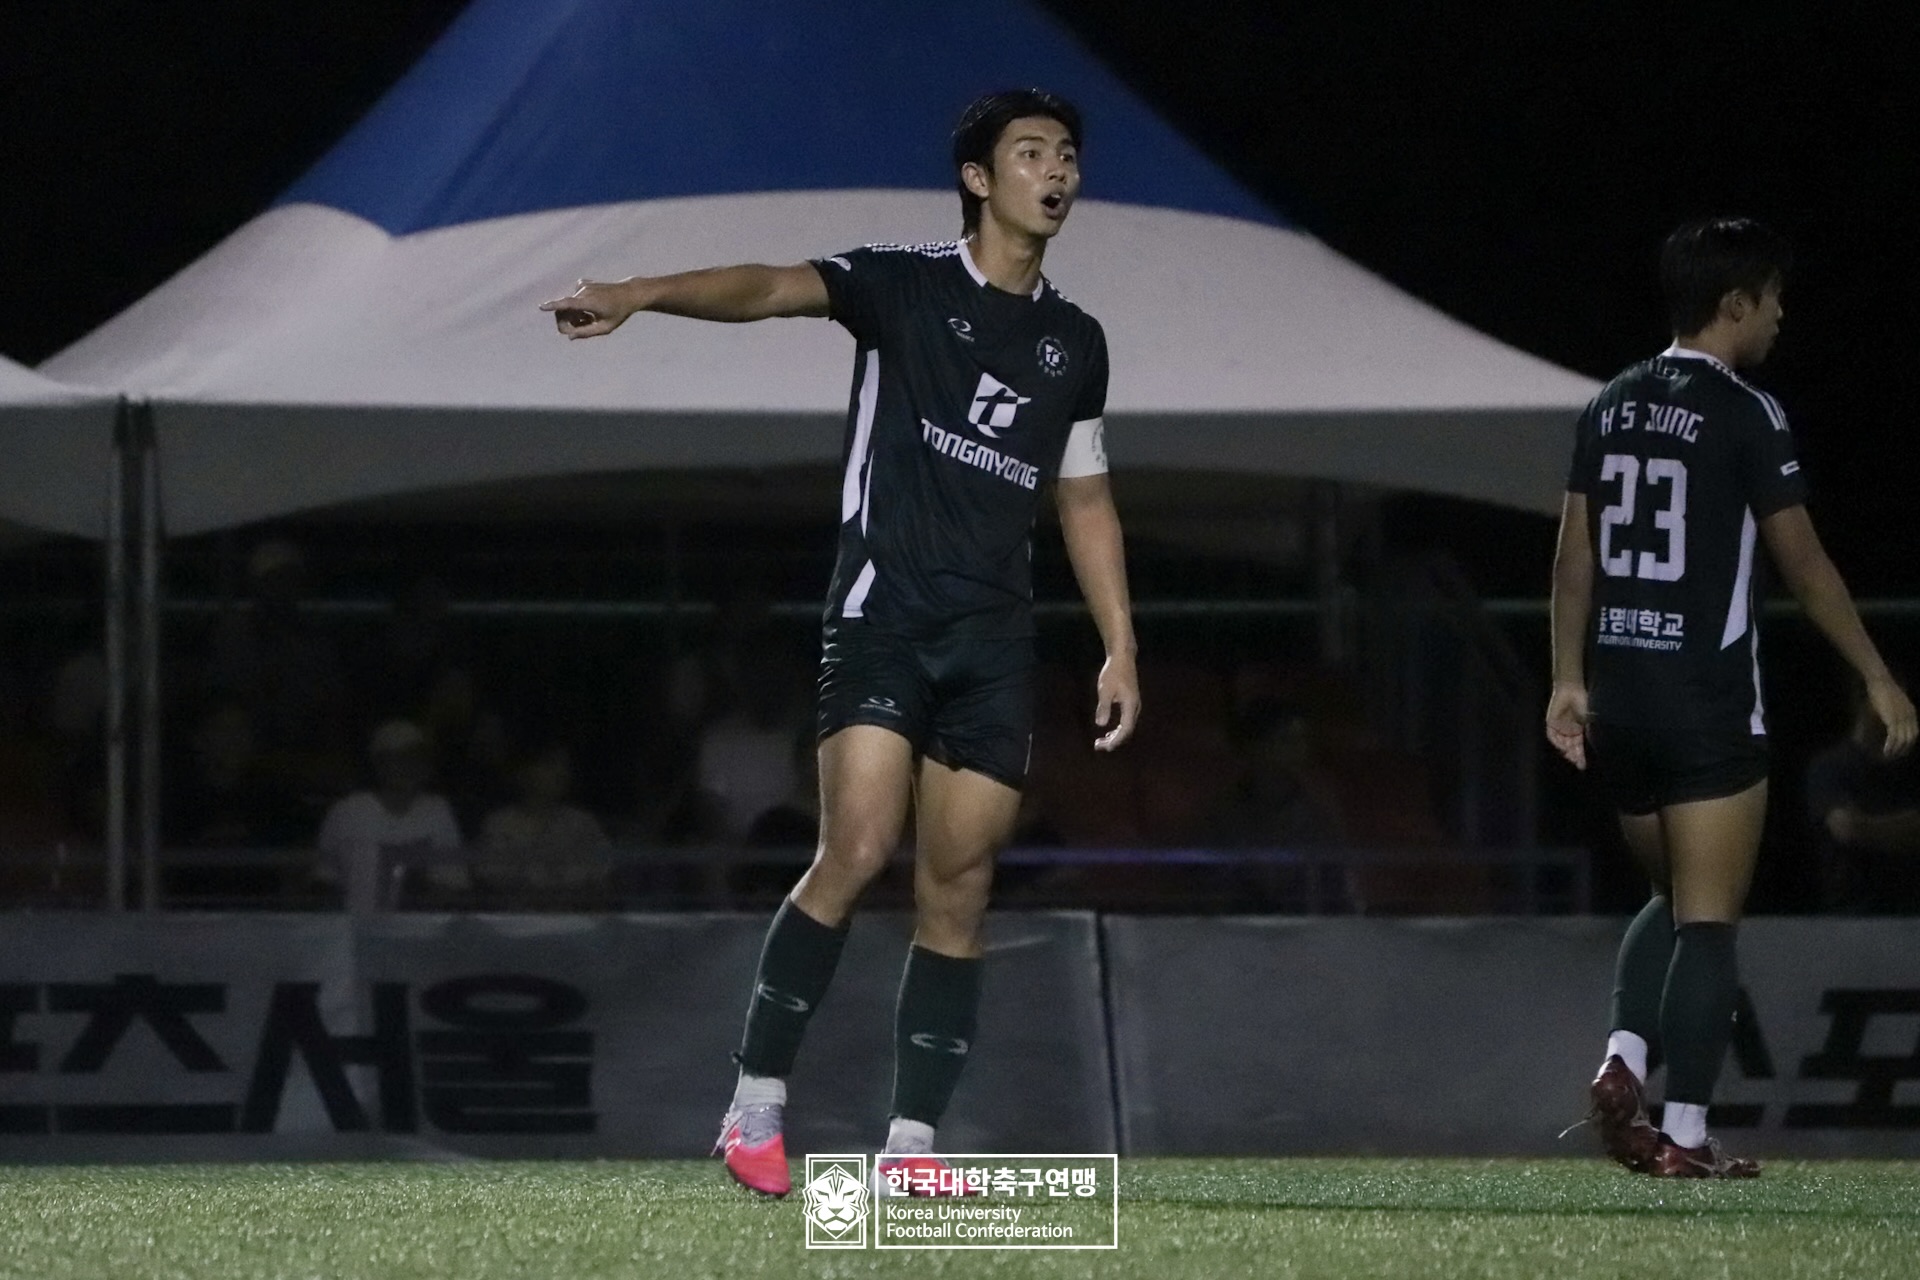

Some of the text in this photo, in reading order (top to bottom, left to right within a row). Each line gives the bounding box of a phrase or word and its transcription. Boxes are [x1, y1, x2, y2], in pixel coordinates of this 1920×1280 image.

[921, 418, 1039, 490] TONGMYONG
[1601, 401, 1704, 444] H S JUNG
[1600, 454, 1688, 582] 23
[0, 972, 597, 1135] 츠서울
